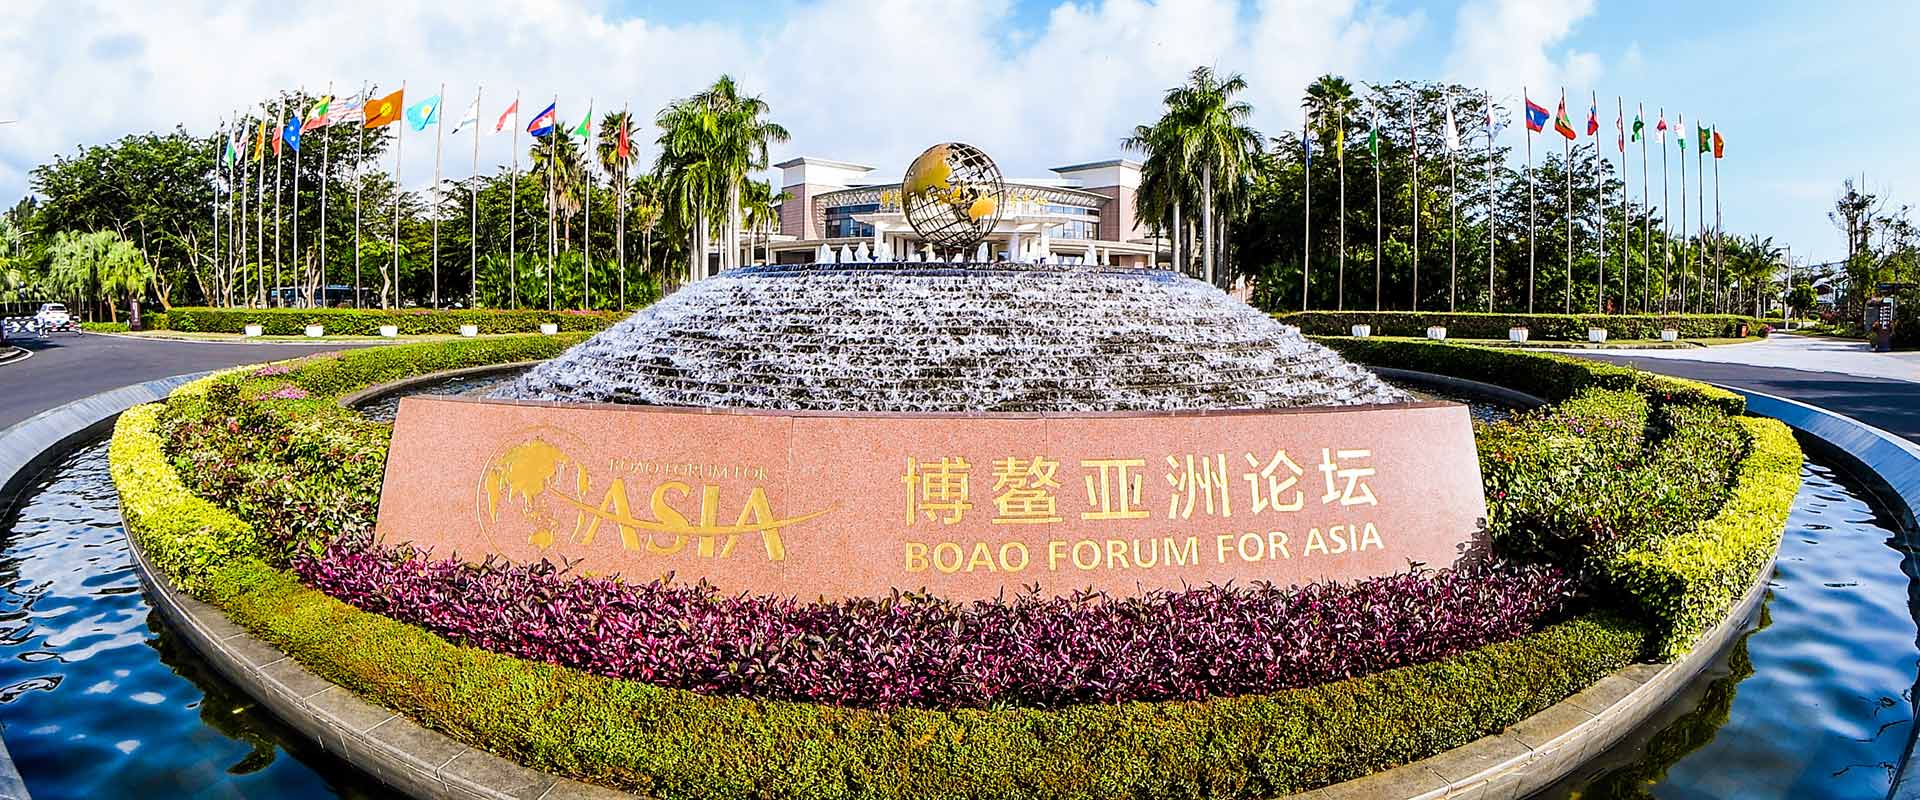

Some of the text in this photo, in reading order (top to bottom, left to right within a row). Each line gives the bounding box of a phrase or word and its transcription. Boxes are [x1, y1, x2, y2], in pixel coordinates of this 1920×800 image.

[664, 463, 729, 479] FORUM
[735, 466, 769, 480] FOR
[901, 447, 1380, 526] 博鳌亚洲论坛
[581, 478, 786, 561] ASIA
[904, 522, 1385, 574] BOAO FORUM FOR ASIA
